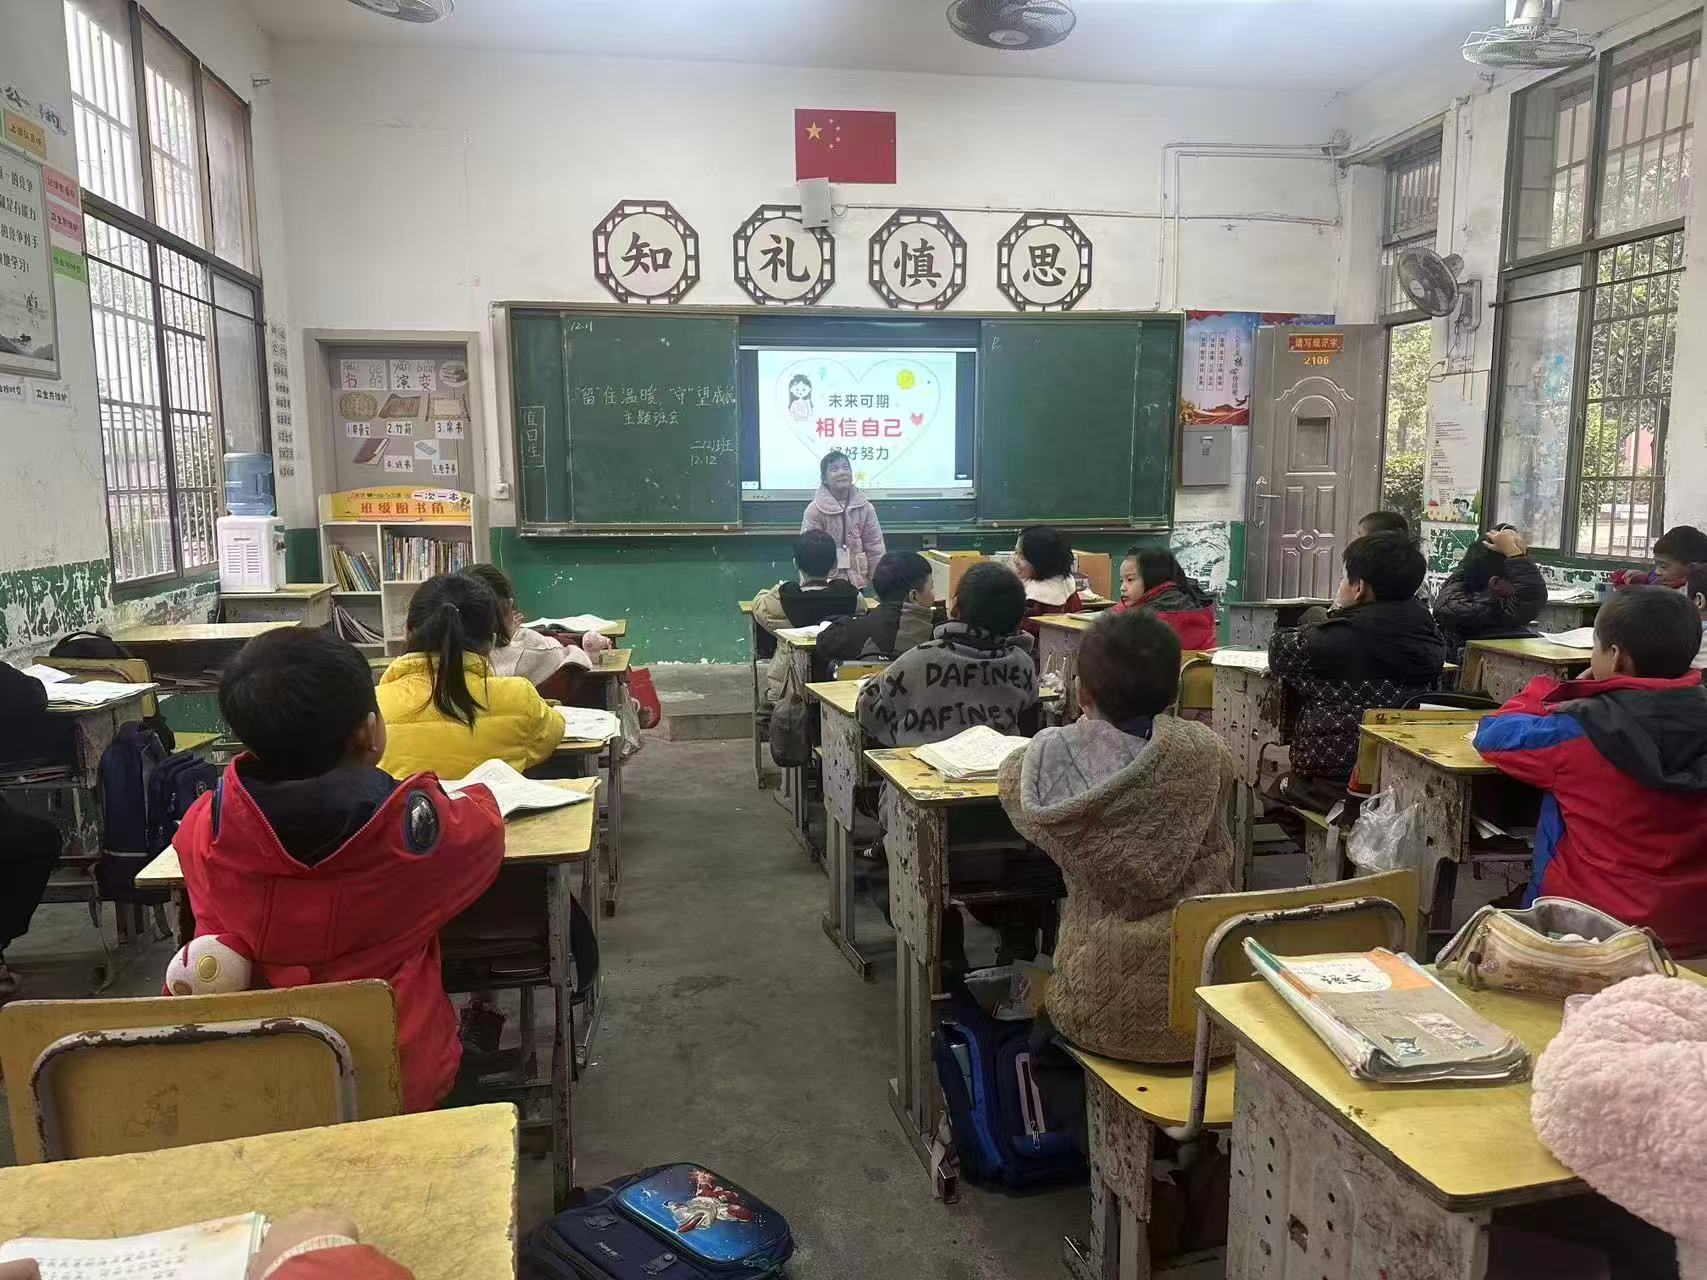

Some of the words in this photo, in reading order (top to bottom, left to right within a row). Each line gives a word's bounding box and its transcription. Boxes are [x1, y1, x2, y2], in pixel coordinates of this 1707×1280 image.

[1, 223, 38, 249] 的竞争对手
[621, 231, 672, 277] 知
[759, 233, 810, 282] 礼
[894, 238, 942, 289] 慎
[1023, 244, 1066, 287] 思
[1295, 337, 1338, 349] 请写规范字
[1304, 356, 1329, 365] 2106
[829, 394, 890, 409] 未来可期
[624, 410, 679, 426] 主题班会
[816, 417, 902, 437] 相信自己
[414, 492, 459, 501] 一次一本
[361, 502, 444, 514] 班级图书角
